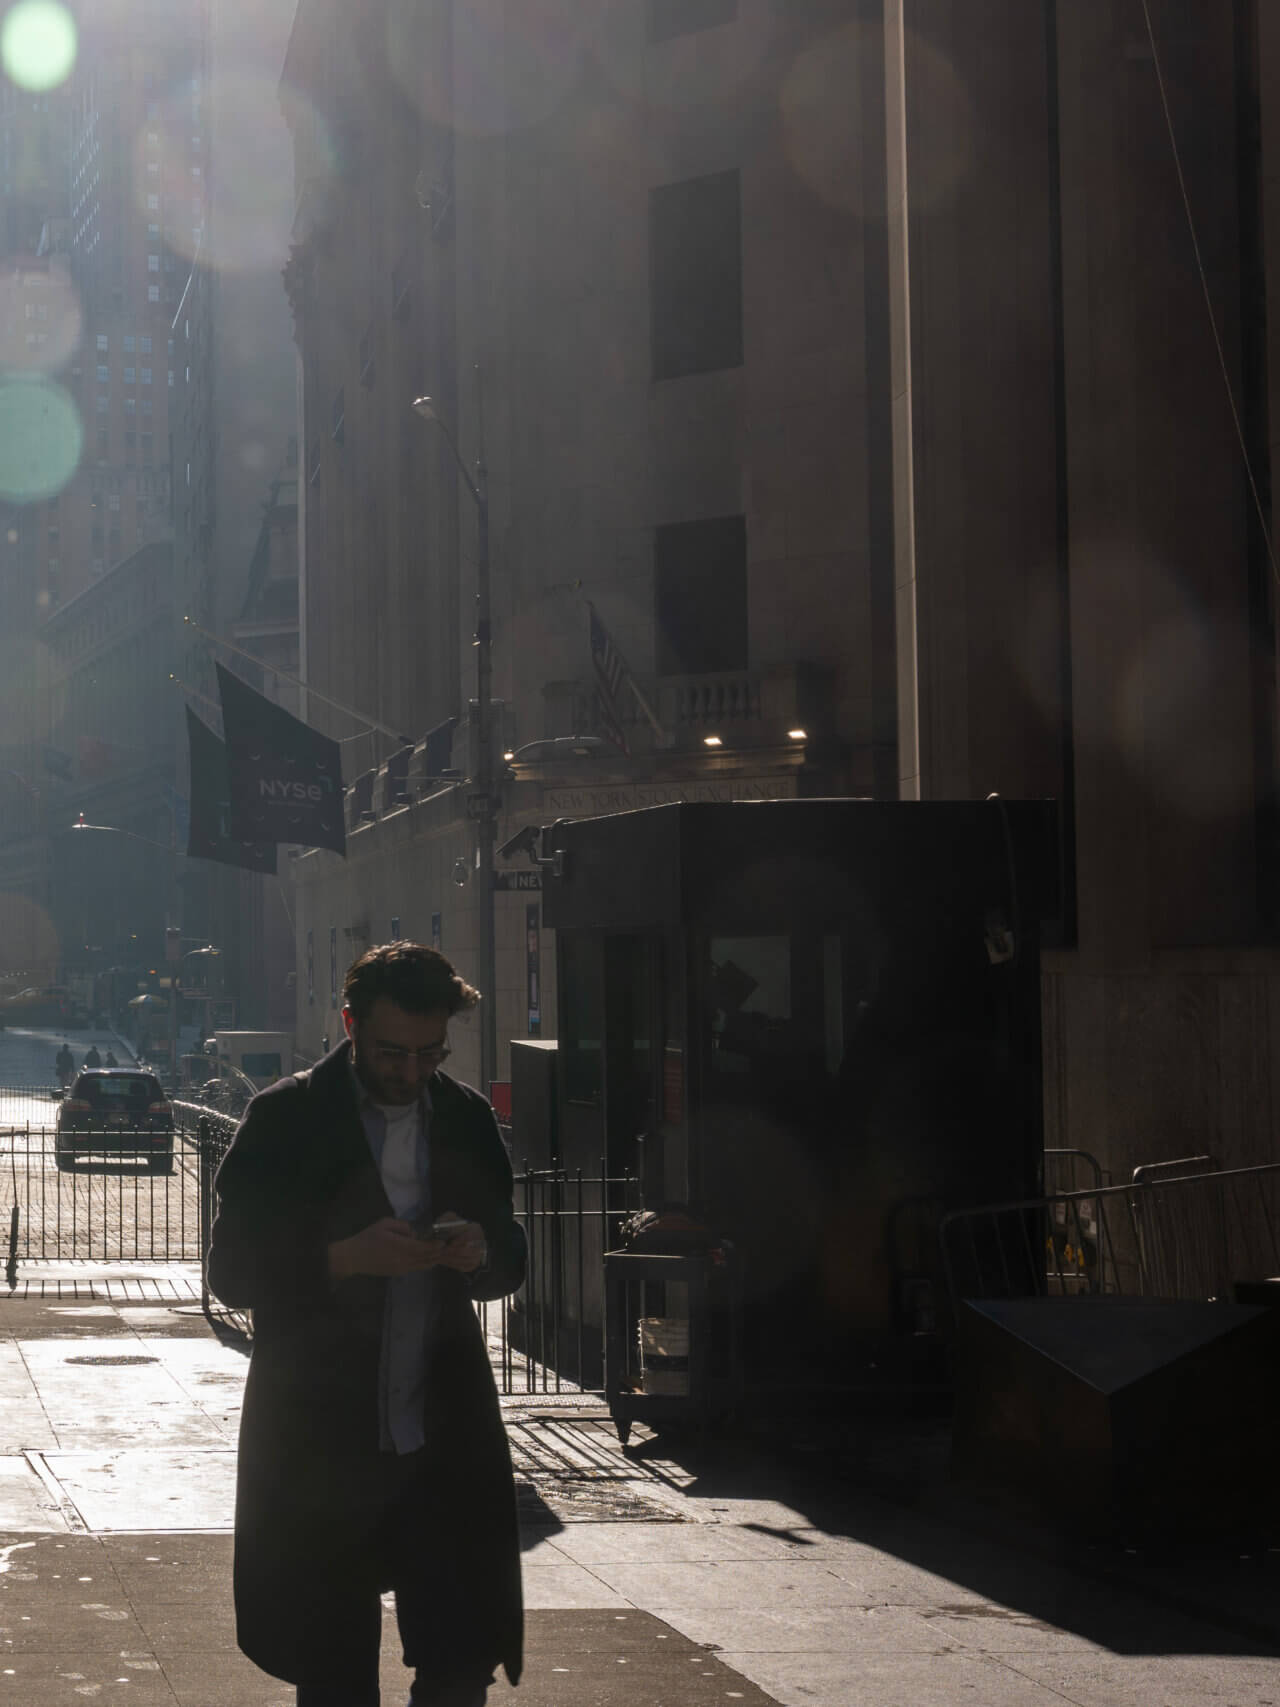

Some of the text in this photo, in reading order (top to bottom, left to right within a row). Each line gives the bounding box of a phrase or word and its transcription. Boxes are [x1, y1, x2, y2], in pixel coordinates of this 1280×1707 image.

[550, 791, 583, 809] NEW
[590, 789, 631, 808] YORK
[520, 874, 543, 888] NE
